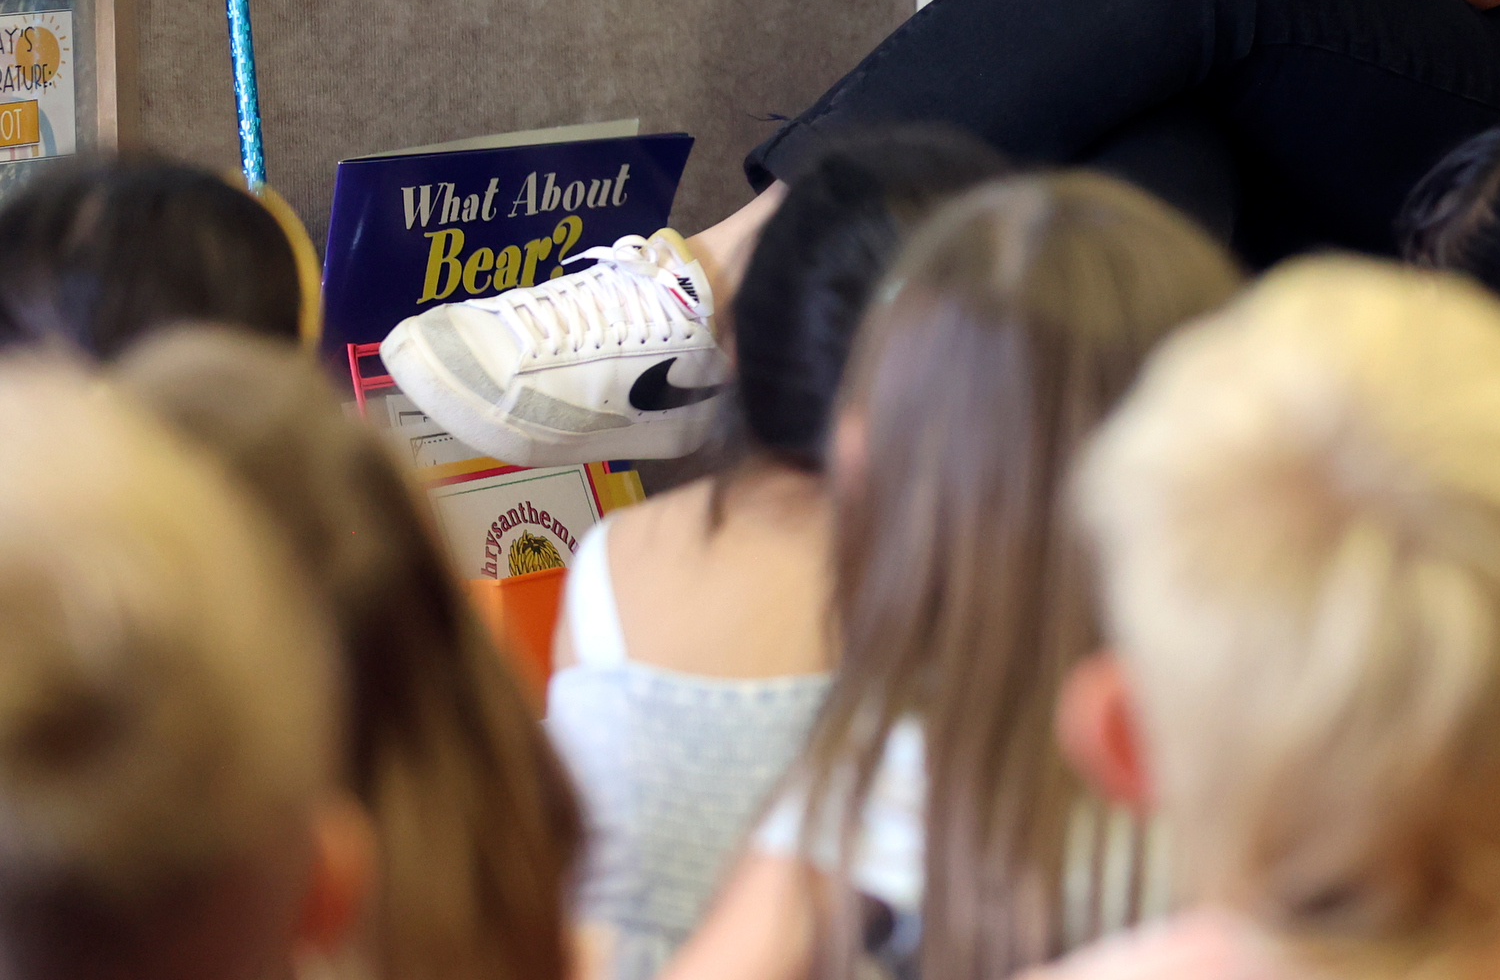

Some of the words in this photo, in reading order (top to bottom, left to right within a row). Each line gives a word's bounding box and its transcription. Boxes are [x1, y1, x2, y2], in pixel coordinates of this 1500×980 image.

[0, 64, 52, 93] ATURE:
[401, 177, 499, 230] What
[508, 163, 630, 218] About
[417, 215, 583, 304] Bear?
[481, 500, 580, 580] hrysanthemu
